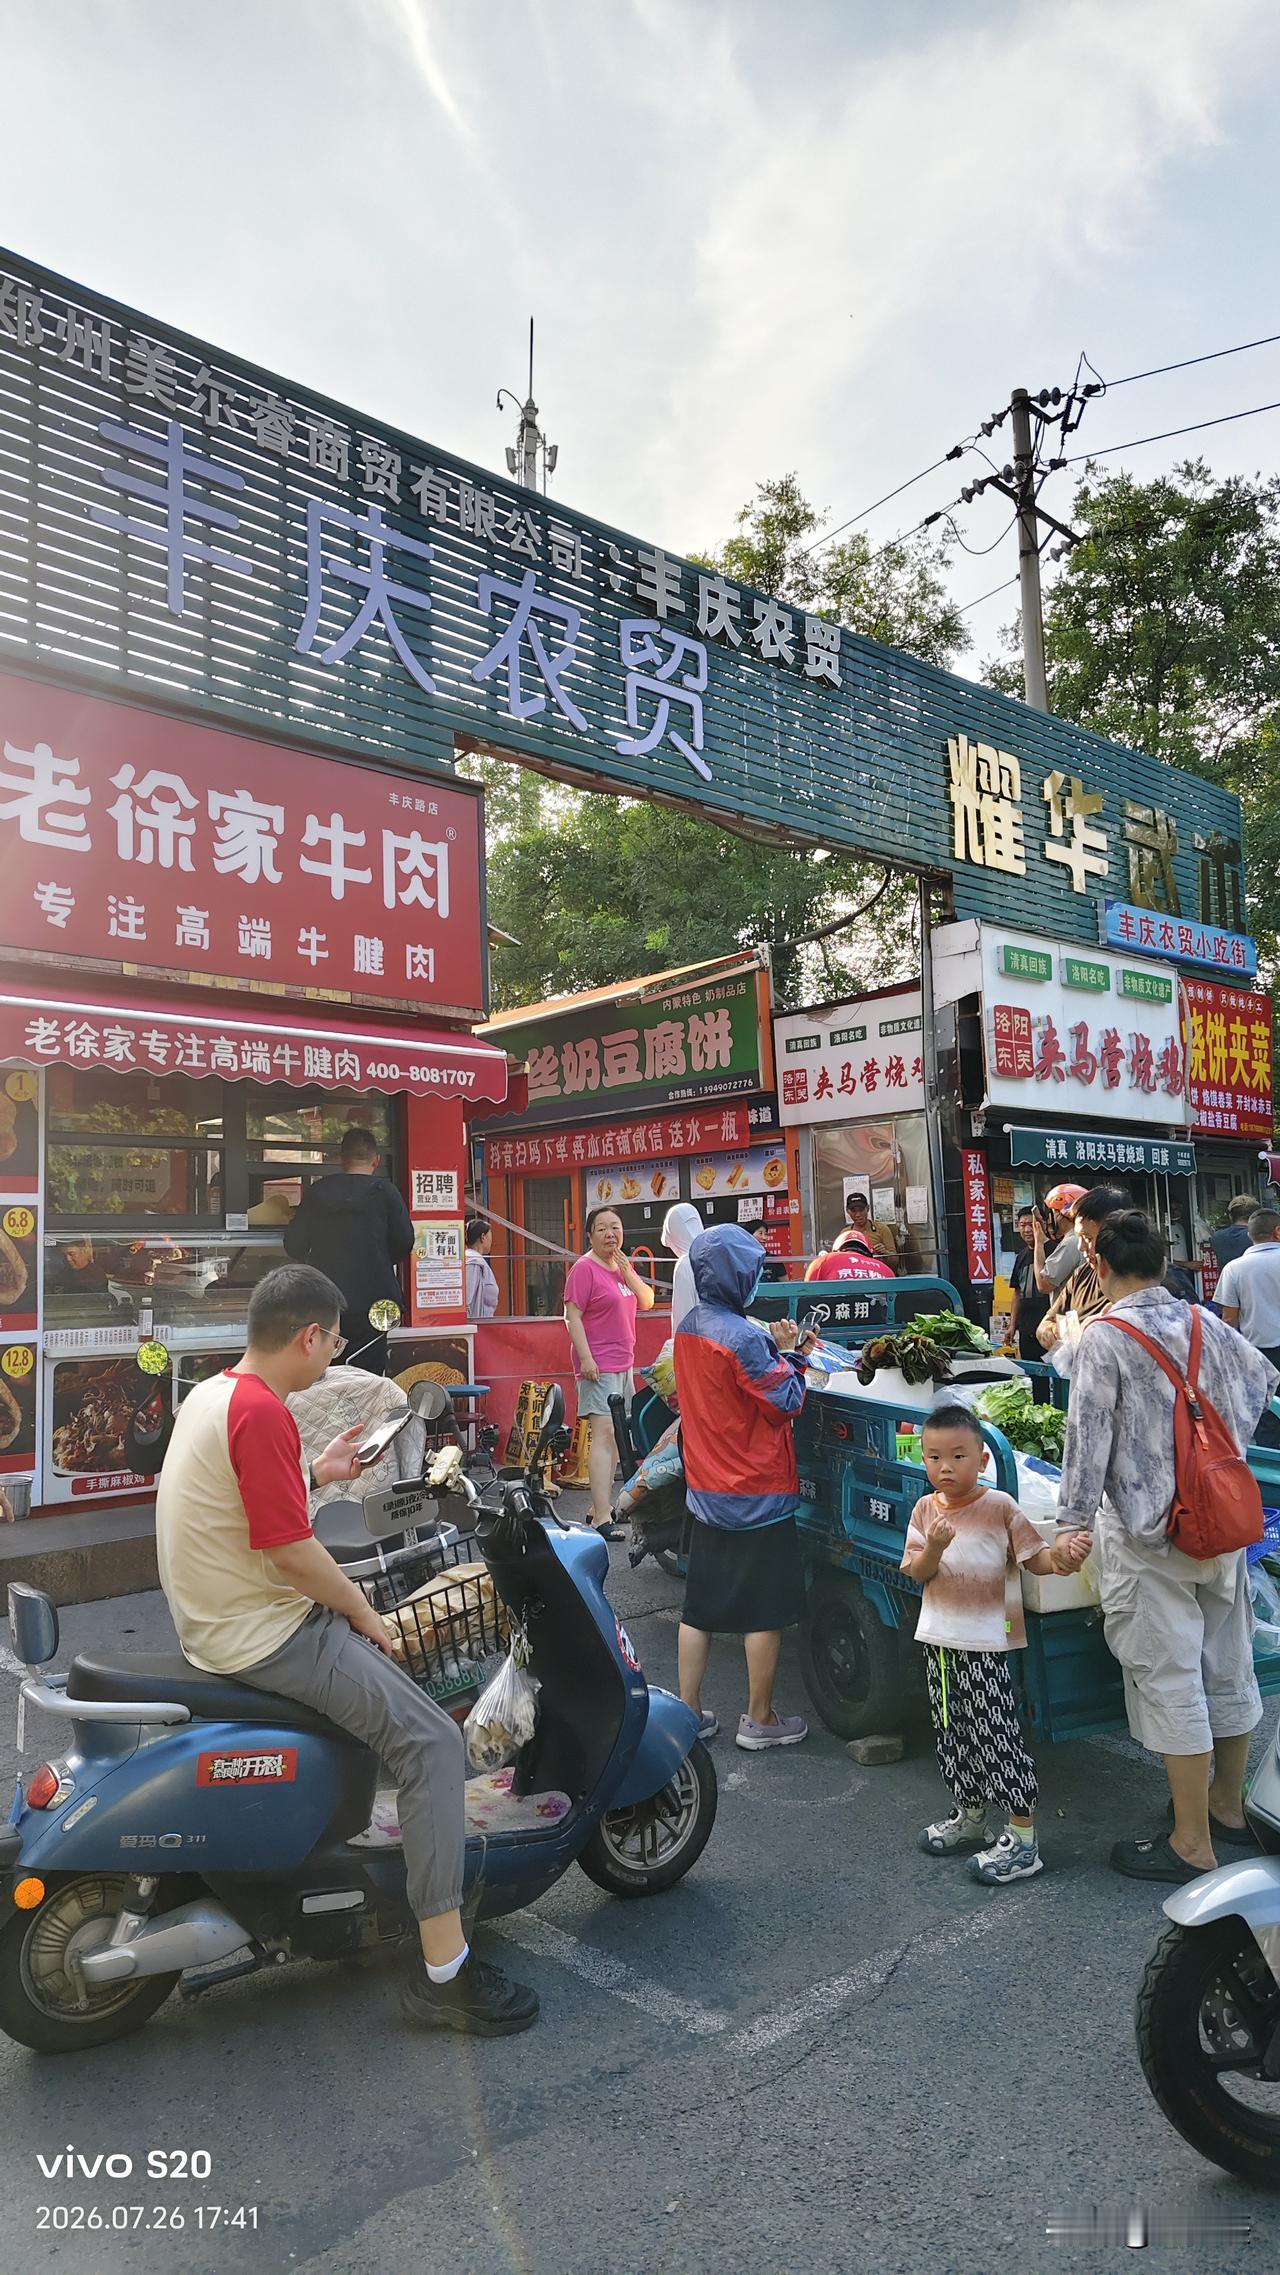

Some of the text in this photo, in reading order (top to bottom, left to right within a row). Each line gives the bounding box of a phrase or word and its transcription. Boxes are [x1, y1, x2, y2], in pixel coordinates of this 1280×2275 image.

[92, 420, 712, 781] 丰庆农贸
[389, 792, 439, 815] 丰庆路店
[0, 740, 450, 919] 老徐家牛肉
[33, 881, 435, 983] 专注高端牛腱肉
[1118, 911, 1247, 968] 丰庆农贸小吃街
[1010, 951, 1047, 975] 清真回族
[1071, 964, 1105, 986] 洛阳名吃
[662, 981, 747, 1011] 内蒙特色 奶制品店
[1123, 974, 1172, 1000] 非物质文化遗产
[833, 1028, 863, 1045] 洛阳名吃
[995, 1012, 1029, 1037] 洛阳
[25, 1016, 361, 1081] 老徐家专注高端牛腱肉
[509, 1008, 734, 1101] 丝奶豆腐饼
[789, 1036, 818, 1051] 清真回族
[1034, 1014, 1185, 1097] 夹马营烧鸡
[997, 1046, 1033, 1071] 东关
[783, 1070, 808, 1086] 洛阳
[1195, 1109, 1238, 1131] 椒盐香豆腐
[489, 1110, 739, 1170] 抖音扫码下单 再加店铺微信 送水一瓶
[1046, 1137, 1068, 1160] 清真
[1075, 1139, 1145, 1166] 洛阳夹马营烧鸡
[1151, 1147, 1170, 1168] 回族
[416, 1173, 454, 1194] 招聘
[8, 1211, 29, 1228] 6.8
[967, 1153, 990, 1278] 私家车禁入
[834, 1301, 870, 1321] 森翔
[6, 1349, 29, 1368] 12.8
[86, 1474, 145, 1491] 手撕麻椒鸡
[869, 1497, 892, 1523] 翔
[119, 1834, 156, 1848] 爱玛
[186, 1834, 207, 1843] 311
